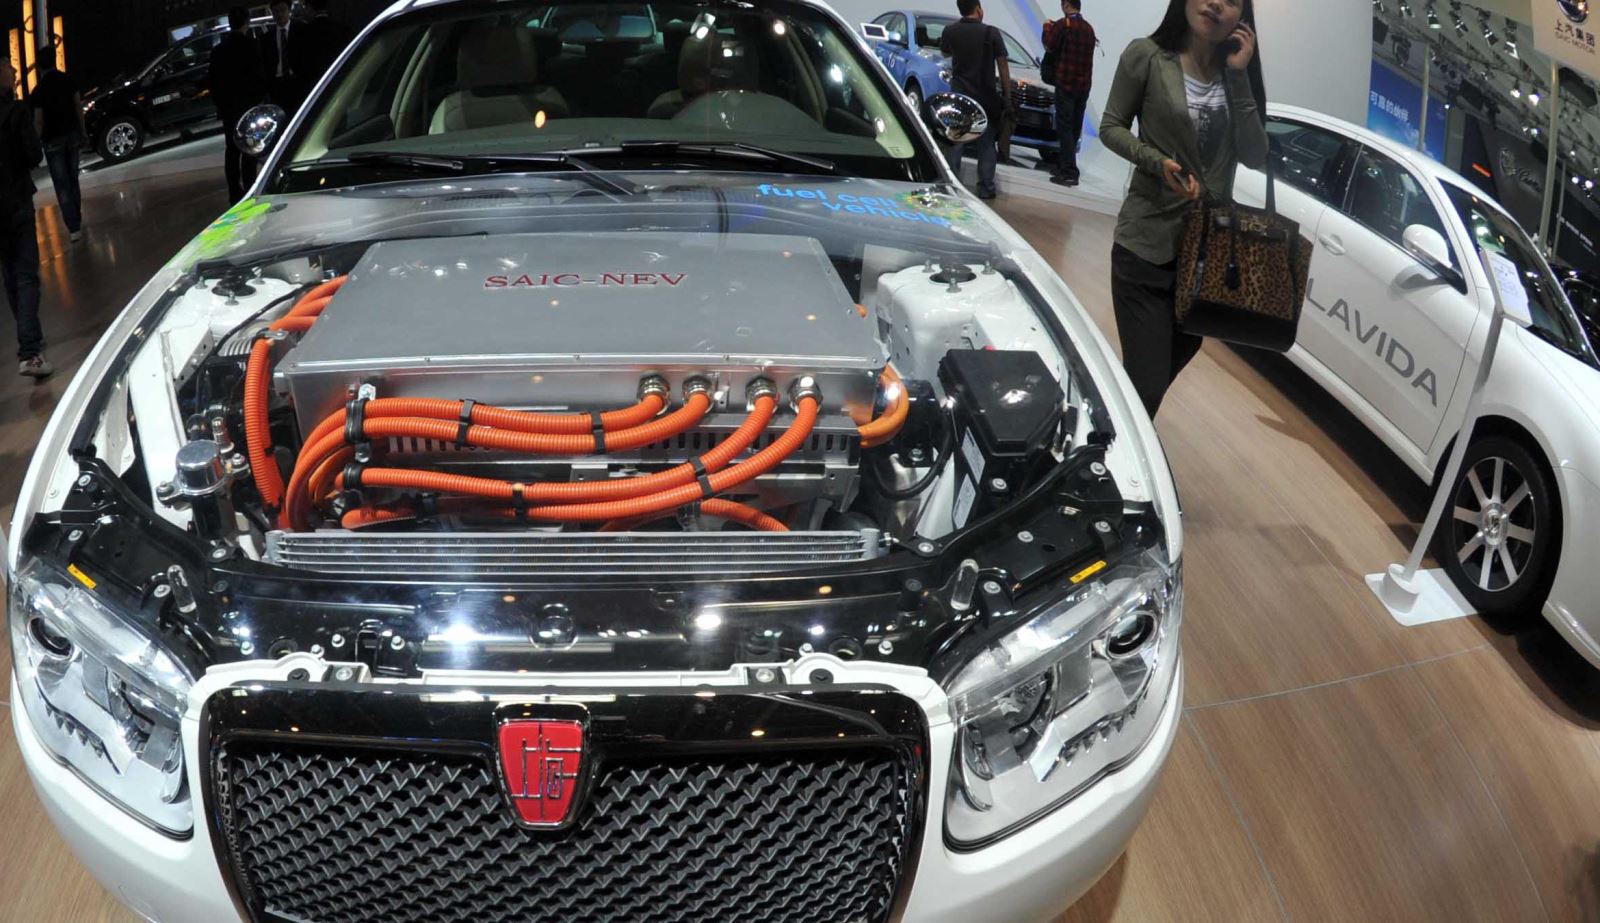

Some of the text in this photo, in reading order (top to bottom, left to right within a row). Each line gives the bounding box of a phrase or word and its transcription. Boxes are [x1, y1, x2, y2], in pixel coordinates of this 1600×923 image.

[757, 184, 898, 208] fuel cell
[822, 202, 950, 227] vehicle
[485, 273, 686, 288] SAIC-NEV
[1306, 278, 1437, 408] LAVIDA
